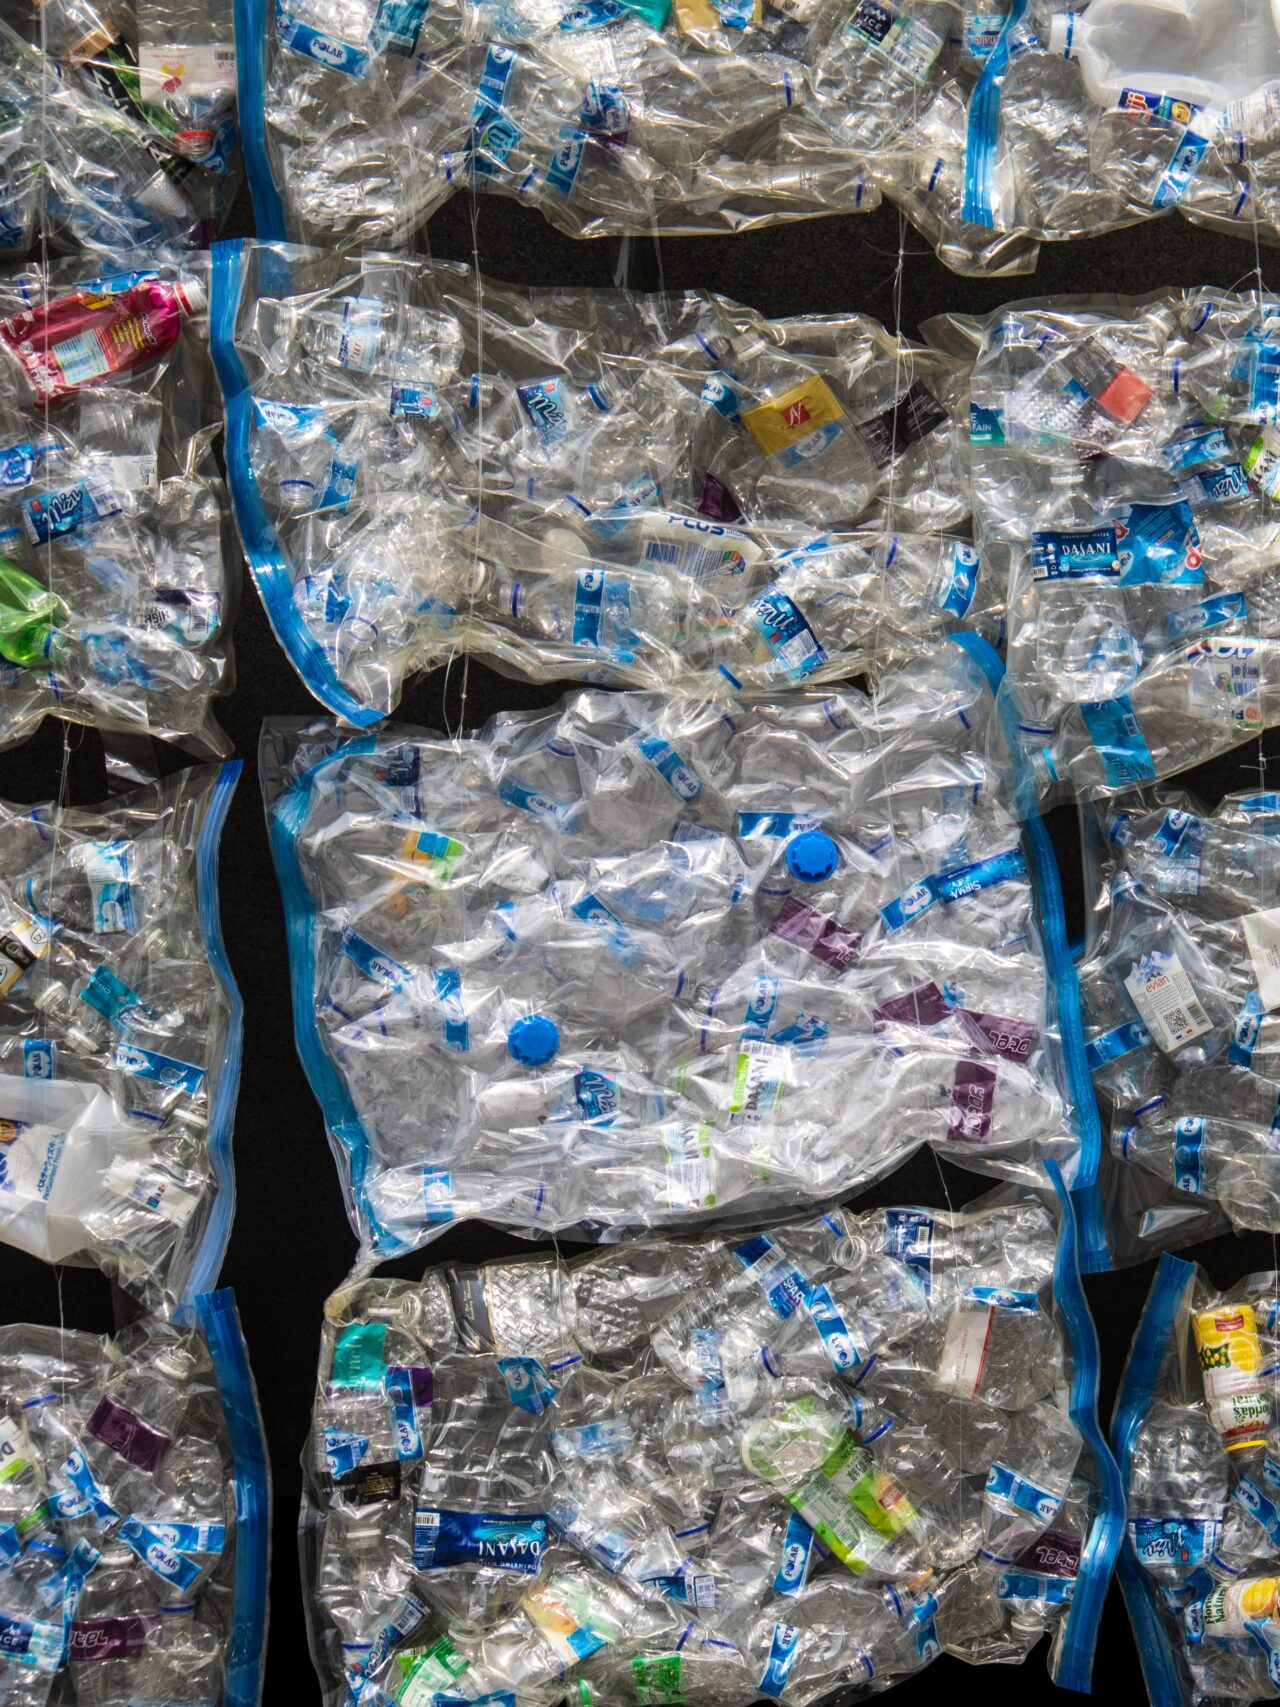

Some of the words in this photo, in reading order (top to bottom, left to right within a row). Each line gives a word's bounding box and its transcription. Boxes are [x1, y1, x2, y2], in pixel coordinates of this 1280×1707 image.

[863, 14, 883, 33] ICE
[313, 38, 343, 60] POLAR
[1211, 468, 1248, 499] Mizu
[45, 489, 84, 528] Mizu
[1060, 543, 1111, 559] DASANI
[751, 601, 798, 631] Mizu
[673, 770, 697, 795] POLAR
[903, 887, 928, 909] POLAR
[951, 880, 983, 900] SIRMA
[372, 959, 403, 985] POLAR
[1145, 975, 1171, 993] evian
[756, 982, 768, 1013] POLAR
[783, 1275, 805, 1304] SPAR
[831, 1336, 850, 1367] POLAR
[398, 1422, 412, 1454] POLAR
[477, 1539, 541, 1558] DASANI
[1144, 1527, 1184, 1557] Mizu
[150, 1546, 178, 1572] POLAR
[784, 1544, 800, 1579] POLAR
